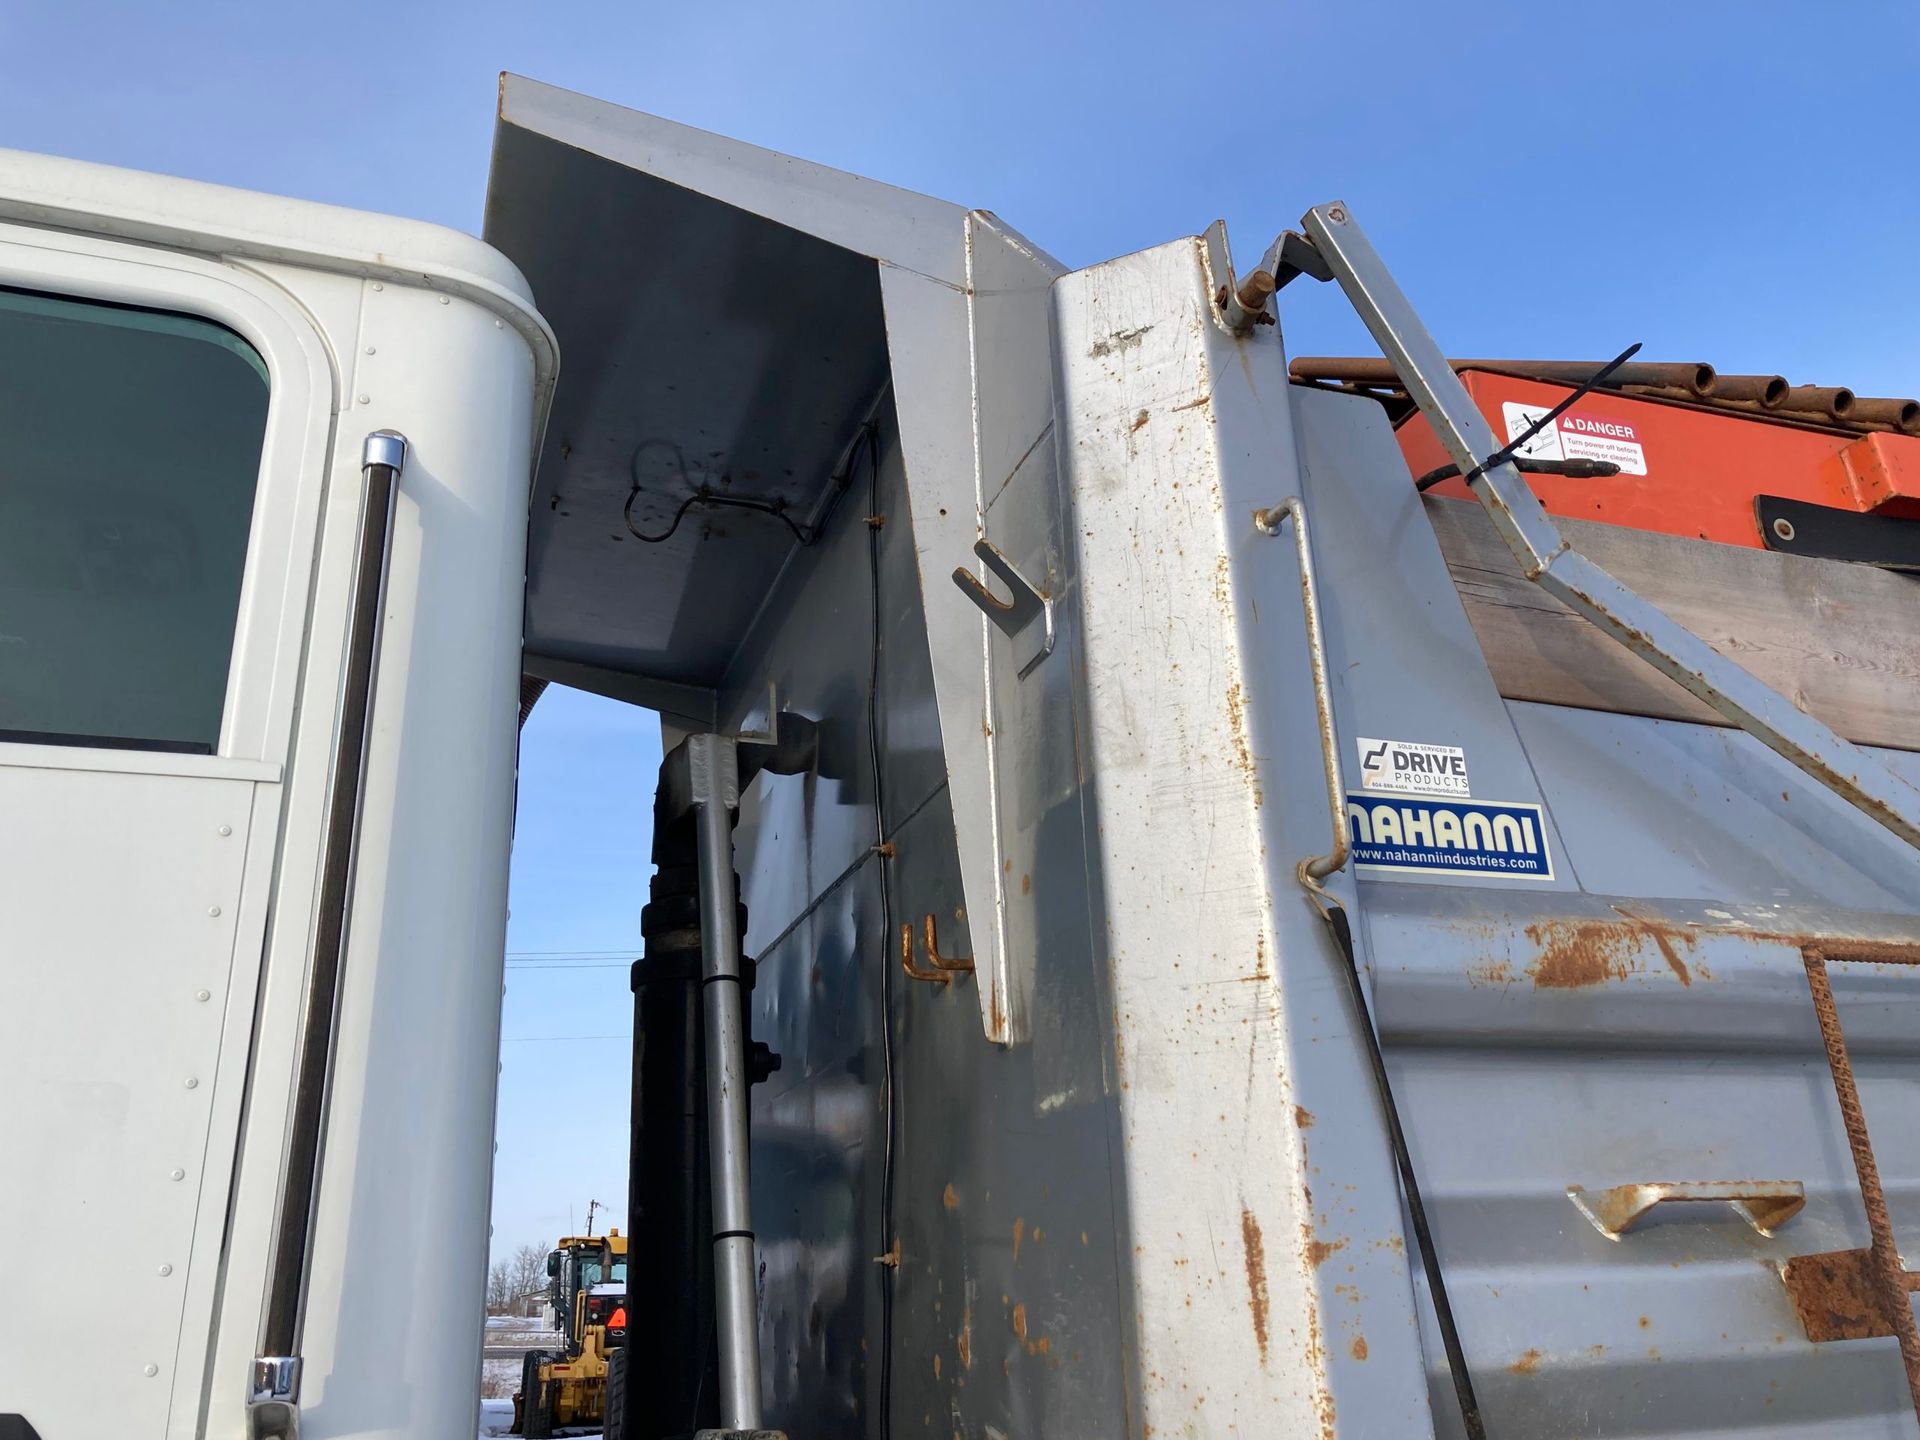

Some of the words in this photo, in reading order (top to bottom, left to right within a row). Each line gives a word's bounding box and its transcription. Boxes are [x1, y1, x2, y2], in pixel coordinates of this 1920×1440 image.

[1576, 419, 1635, 438] DANGER
[1567, 438, 1583, 446] Turn
[1584, 441, 1605, 449] power
[1616, 445, 1638, 454] before
[1569, 448, 1600, 458] servicing
[1609, 455, 1638, 464] cleaning
[1392, 750, 1466, 776] DRIVE
[1395, 772, 1468, 788] PRODUCTS
